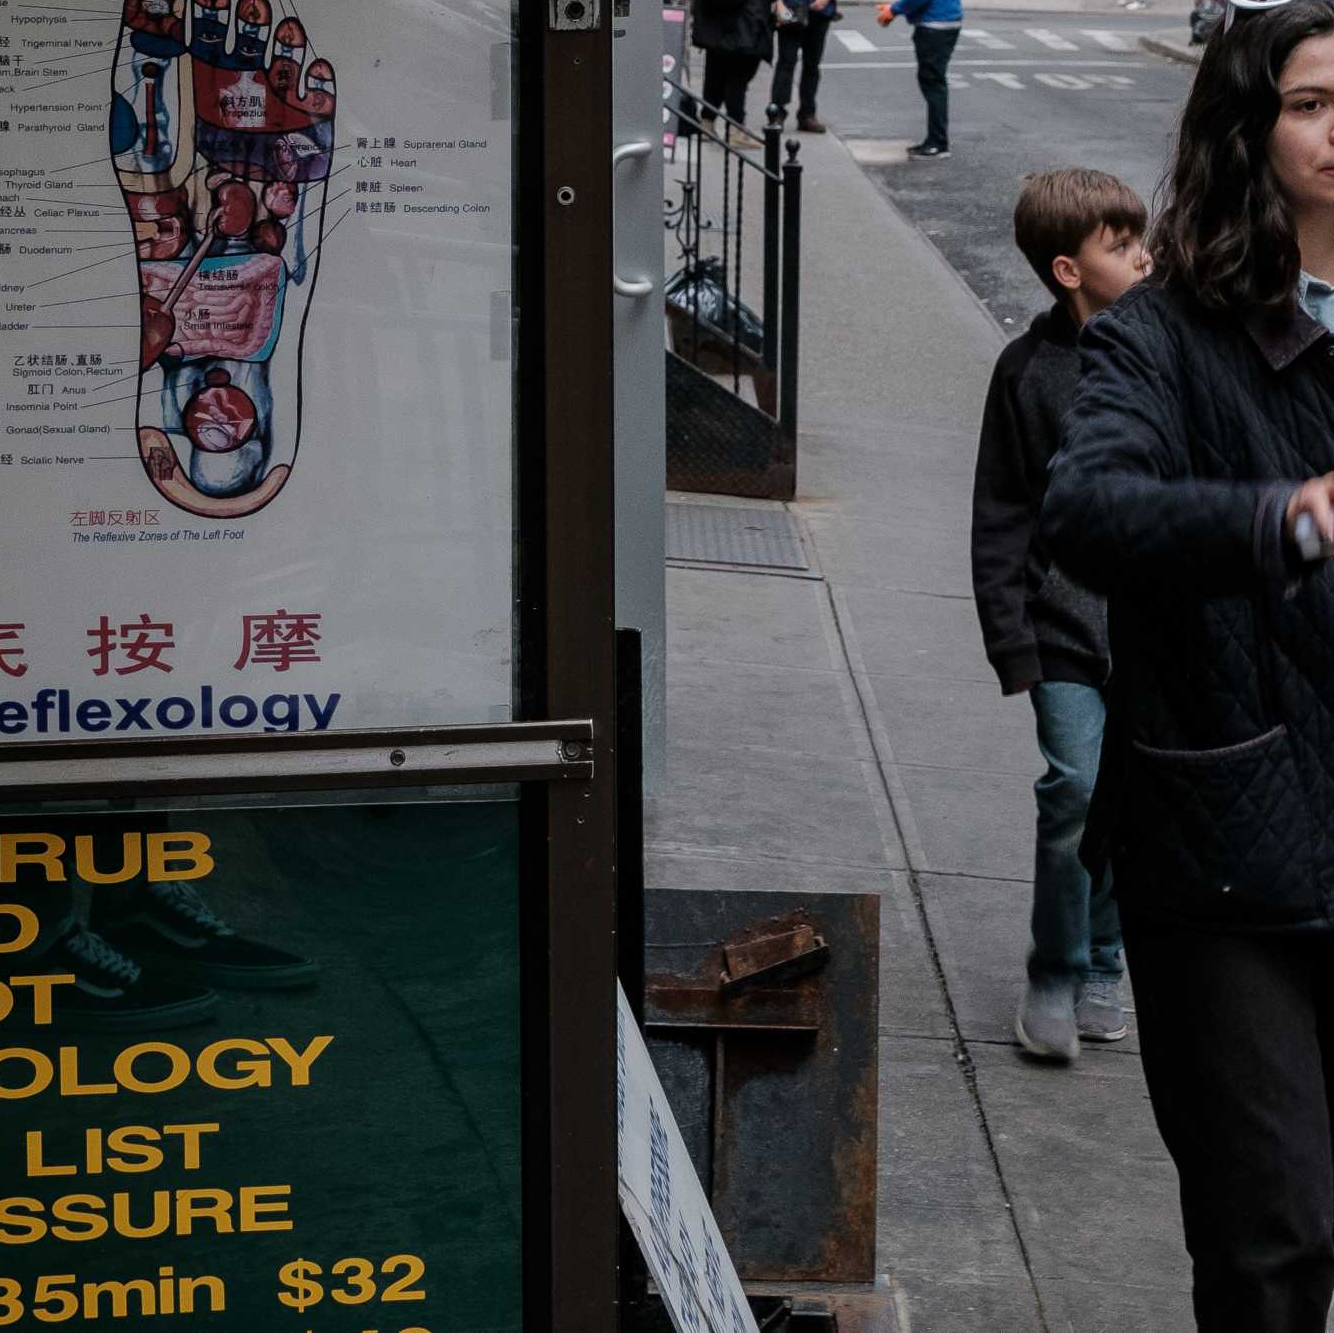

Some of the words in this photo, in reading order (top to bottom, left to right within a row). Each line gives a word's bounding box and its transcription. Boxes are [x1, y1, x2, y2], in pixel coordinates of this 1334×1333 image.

[11, 15, 67, 27] Hypophysis
[21, 39, 71, 50] Trigeminal
[75, 39, 103, 48] Nerve
[42, 68, 68, 77] Stem
[11, 103, 75, 113] Hypertension
[78, 103, 102, 112] Point
[18, 123, 71, 134] Parathyroid
[77, 123, 105, 132] Gland
[404, 140, 455, 151] Suprarenal
[458, 140, 487, 149] Gland
[391, 159, 417, 167] Heart
[5, 180, 41, 191] Thyroid
[44, 180, 73, 189] Gland
[389, 184, 422, 194] Spleen
[34, 209, 65, 217] Celiac
[68, 209, 100, 217] Plexus
[404, 204, 459, 214] Descending
[463, 204, 490, 212] Colon
[19, 245, 73, 255] Duodenum
[5, 303, 36, 312] Ureter
[12, 367, 52, 378] Sigmoid
[61, 386, 86, 395] Anus
[6, 402, 50, 411] Insomnia
[53, 401, 78, 411] Point
[21, 456, 53, 465] Sciatic
[56, 456, 85, 465] Nerve
[72, 532, 90, 543] The
[93, 531, 136, 542] Reflexive
[138, 531, 168, 541] Zones
[170, 530, 180, 541] of
[183, 530, 200, 540] The
[203, 530, 220, 540] Left
[223, 530, 245, 539] Foot
[0, 832, 214, 884] RUB
[27, 1123, 220, 1177] LIST
[278, 1253, 427, 1313] $32
